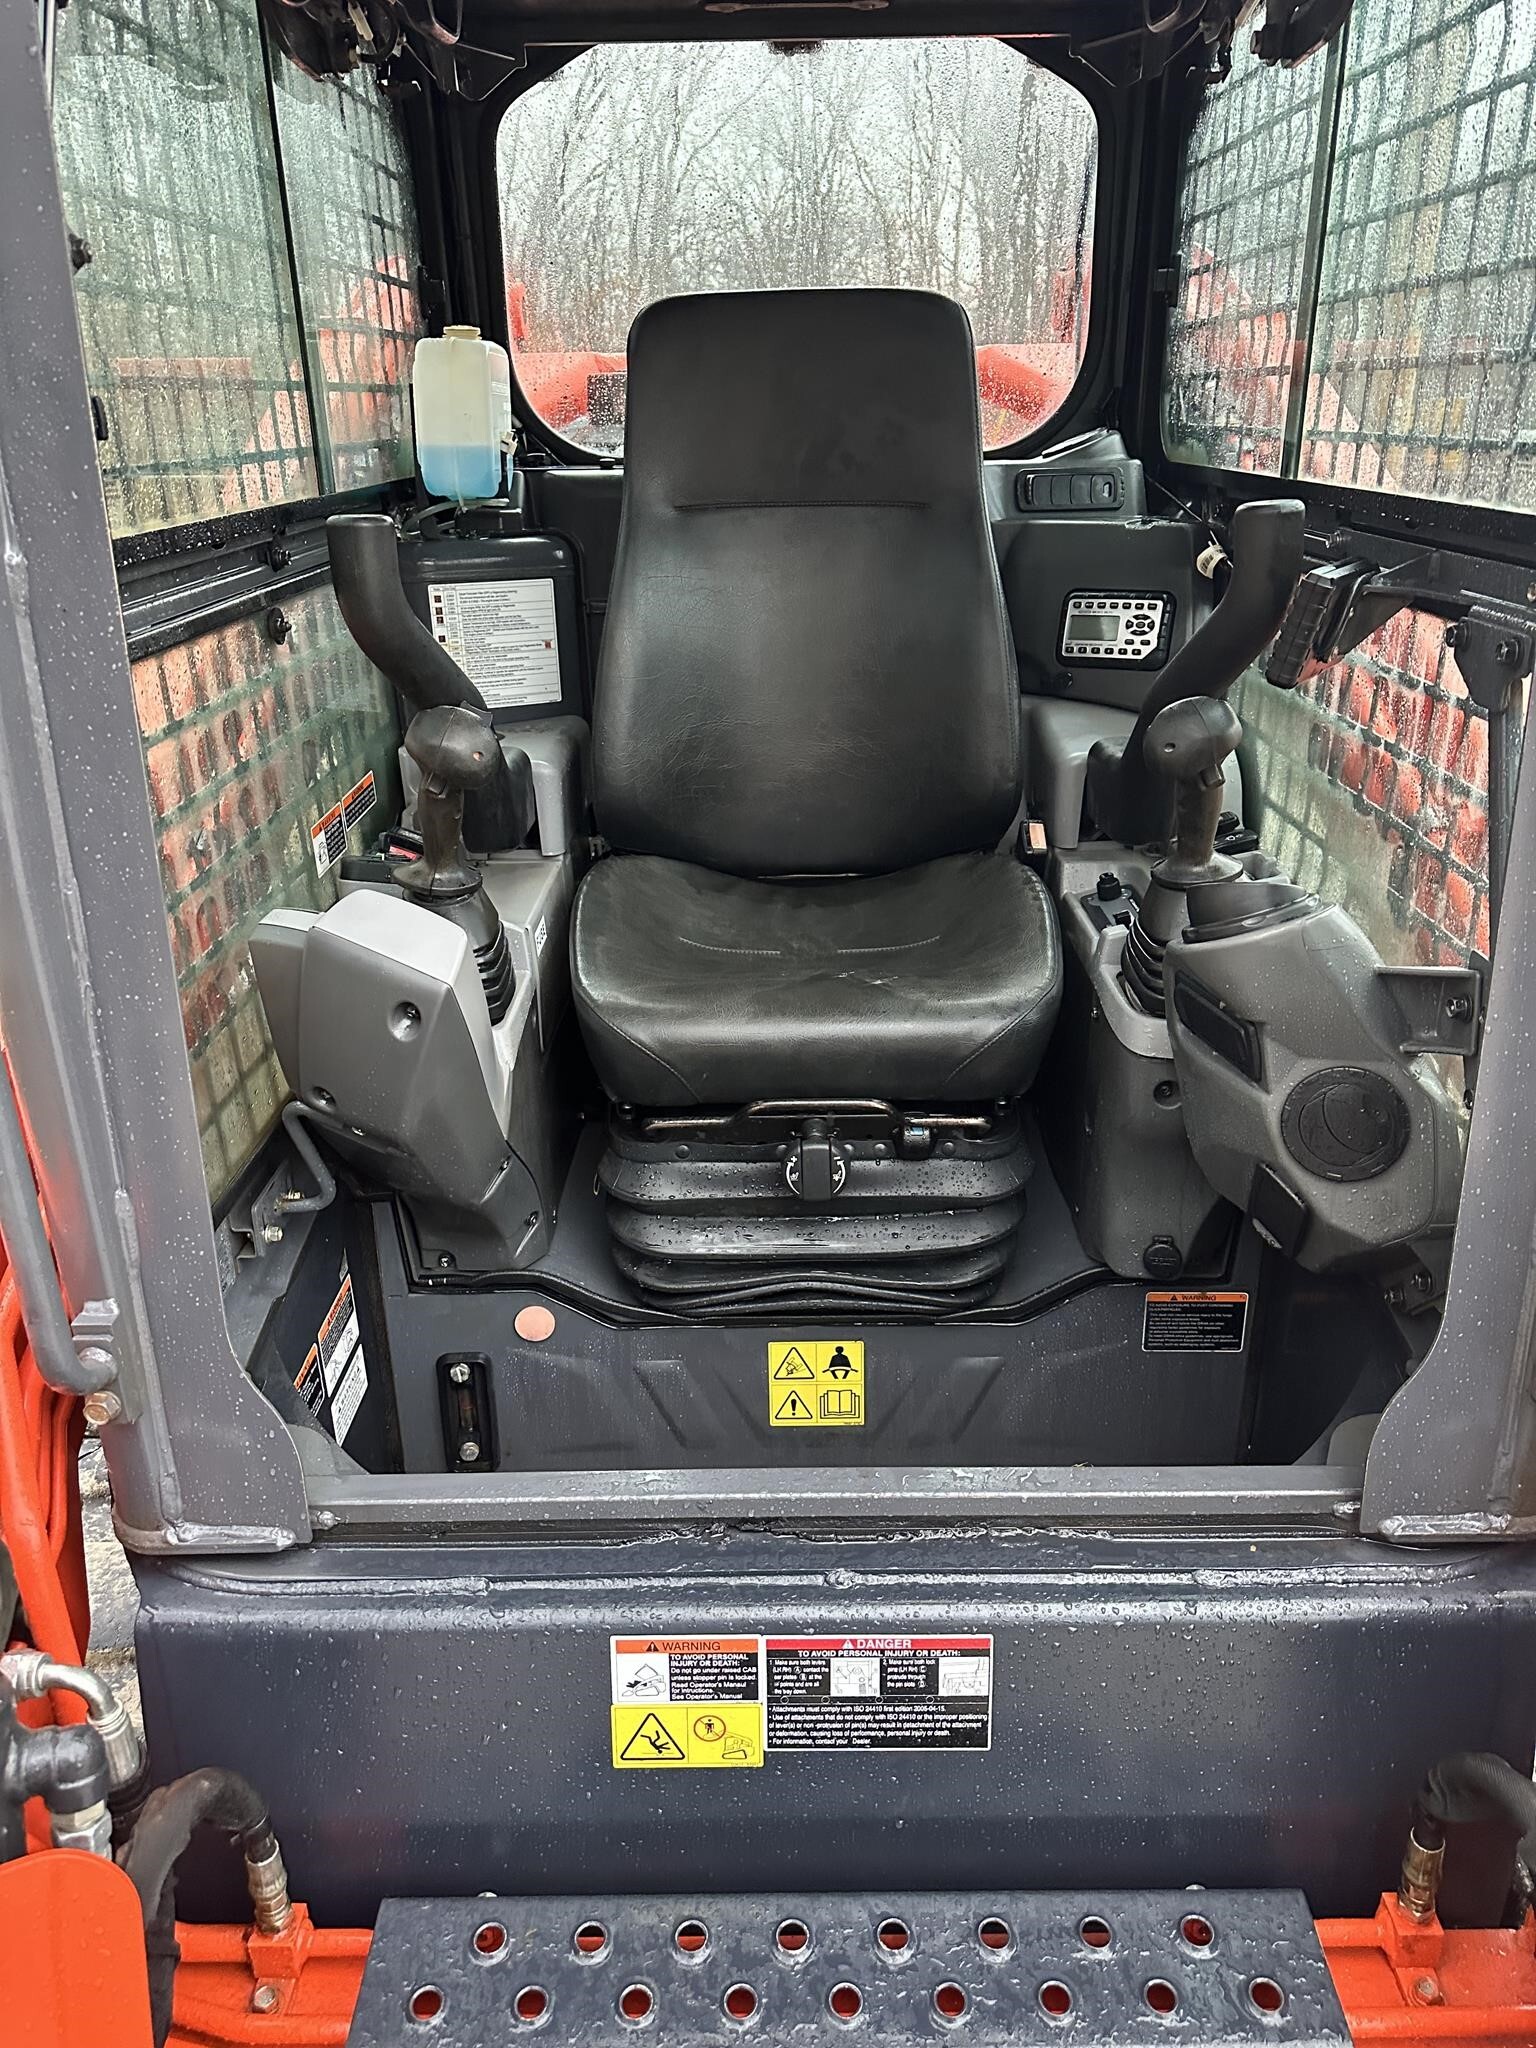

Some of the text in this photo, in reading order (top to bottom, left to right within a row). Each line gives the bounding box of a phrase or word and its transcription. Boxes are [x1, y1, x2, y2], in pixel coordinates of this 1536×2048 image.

[662, 1642, 720, 1651] WARNING
[856, 1640, 912, 1649] DANGER
[798, 1650, 809, 1658] TO
[854, 1714, 874, 1722] comply
